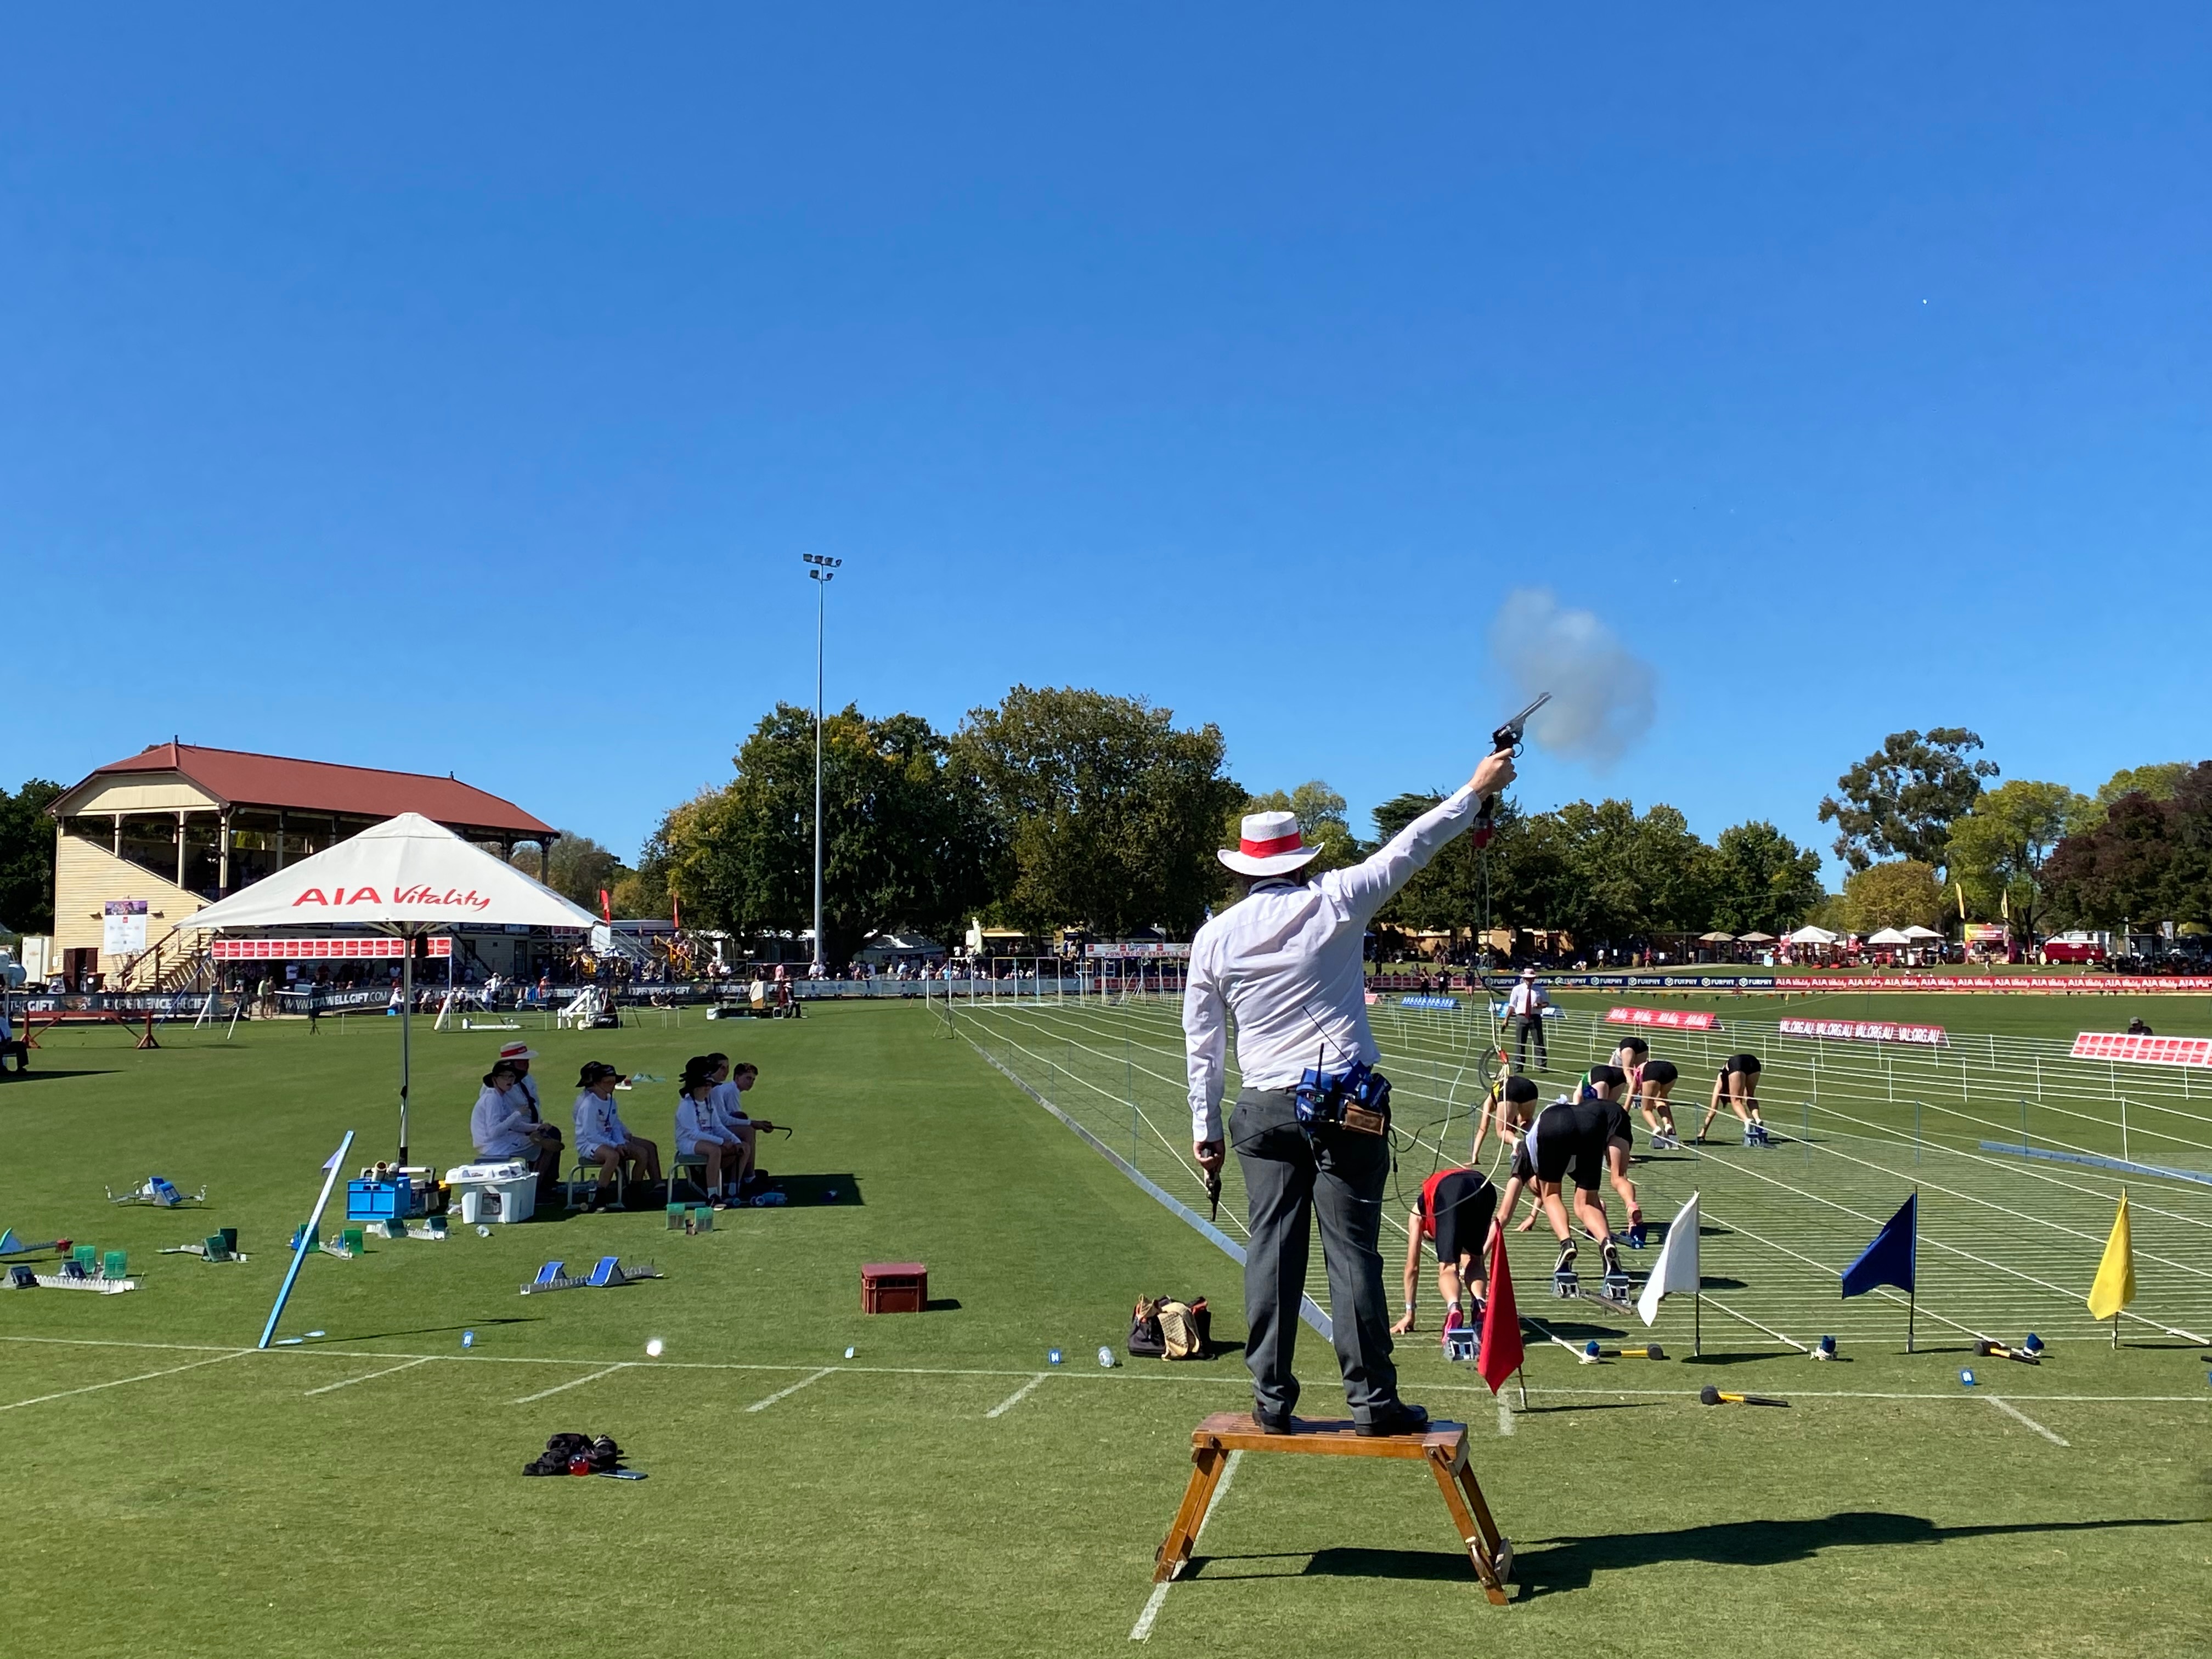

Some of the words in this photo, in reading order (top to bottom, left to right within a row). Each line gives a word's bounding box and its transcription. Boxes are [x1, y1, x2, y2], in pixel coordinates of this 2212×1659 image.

[291, 887, 382, 906] AIA
[393, 884, 490, 912] Vitality
[27, 1000, 55, 1012] GIFT
